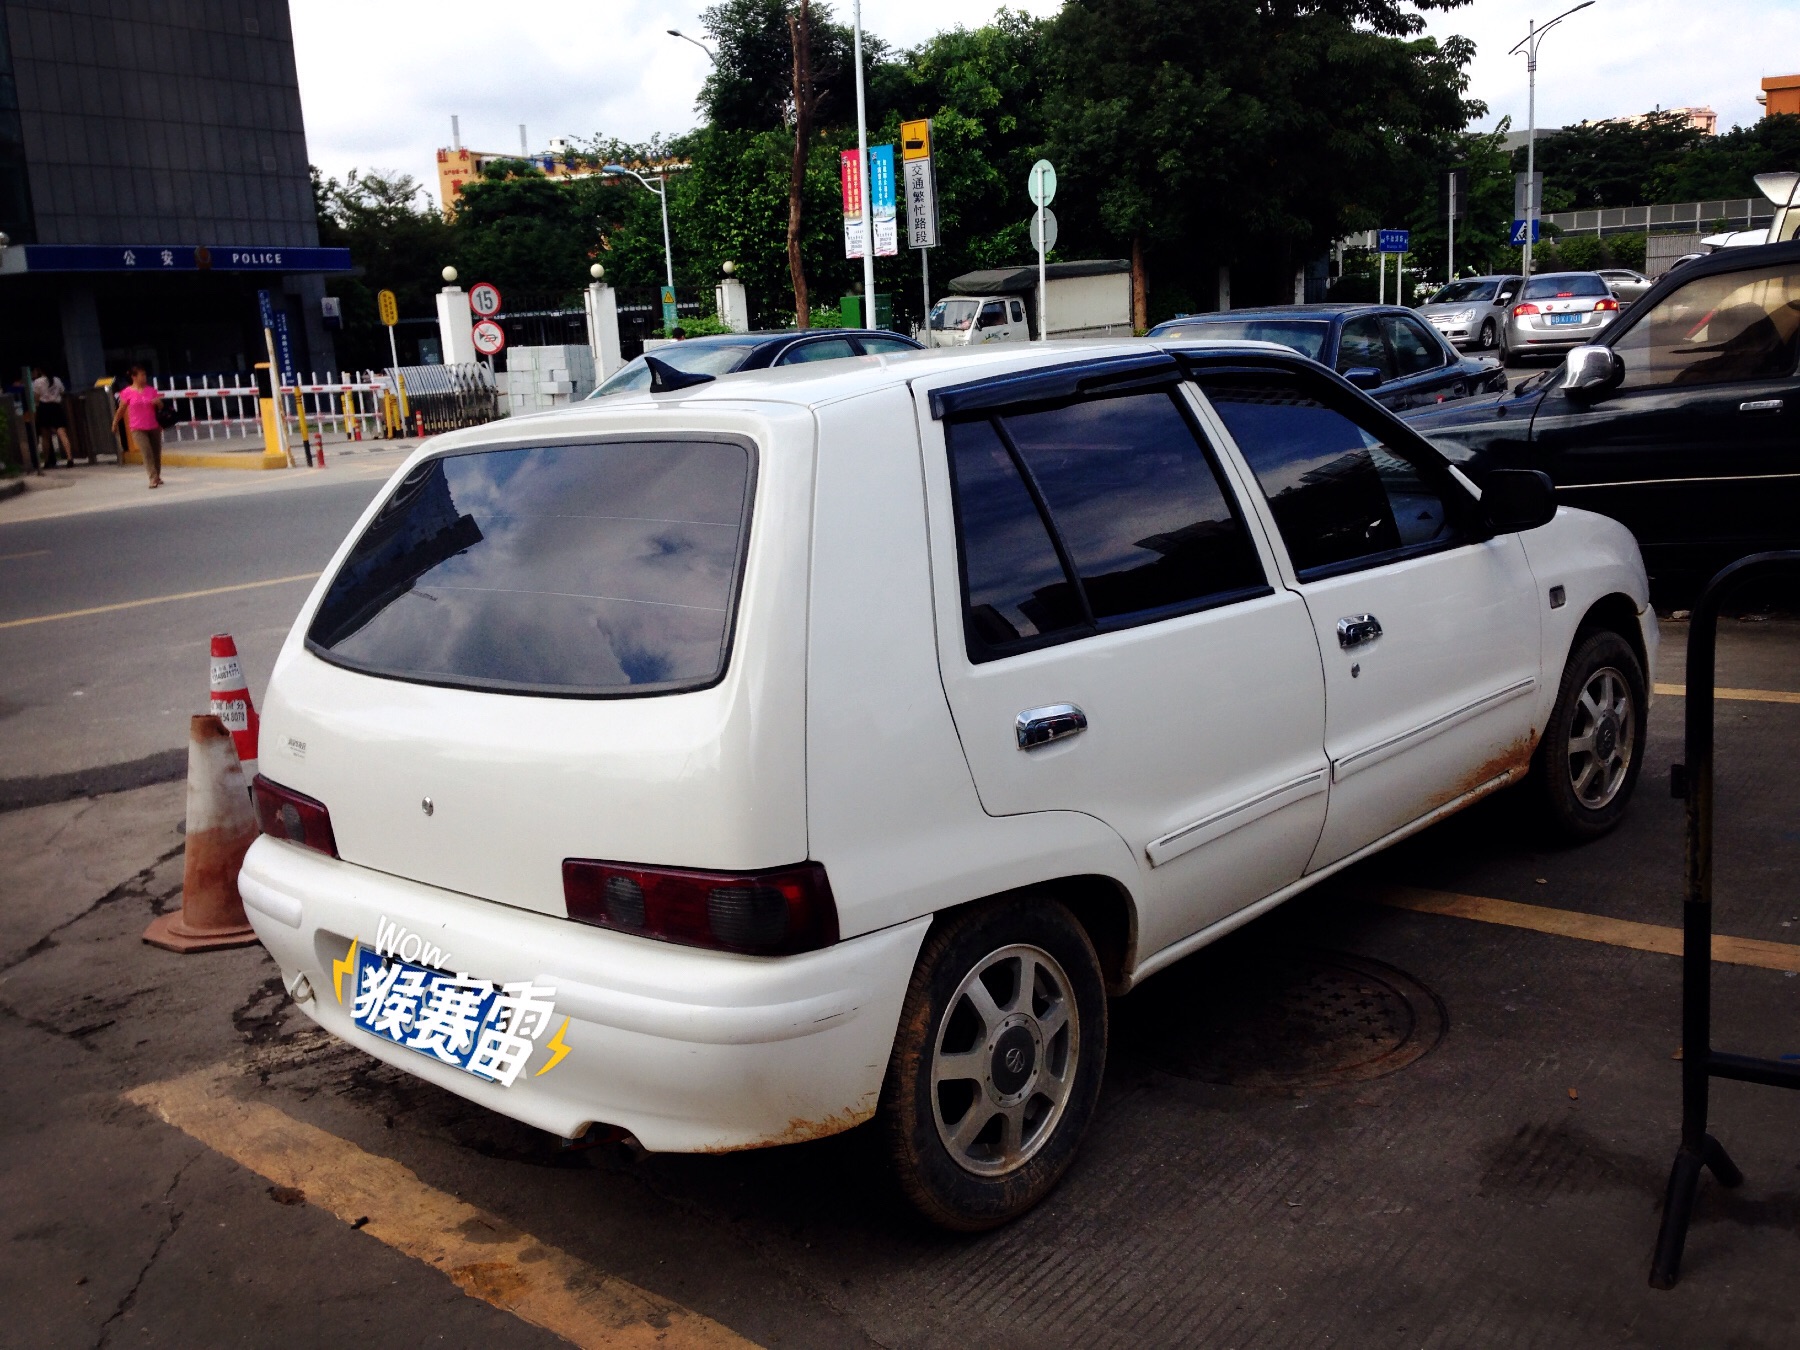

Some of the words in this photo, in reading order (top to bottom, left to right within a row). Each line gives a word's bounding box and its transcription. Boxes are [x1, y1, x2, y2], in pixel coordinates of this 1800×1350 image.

[911, 164, 928, 244] 交通繁忙路段
[123, 250, 174, 266] 公安
[232, 253, 282, 265] POLICE
[476, 290, 493, 311] 15
